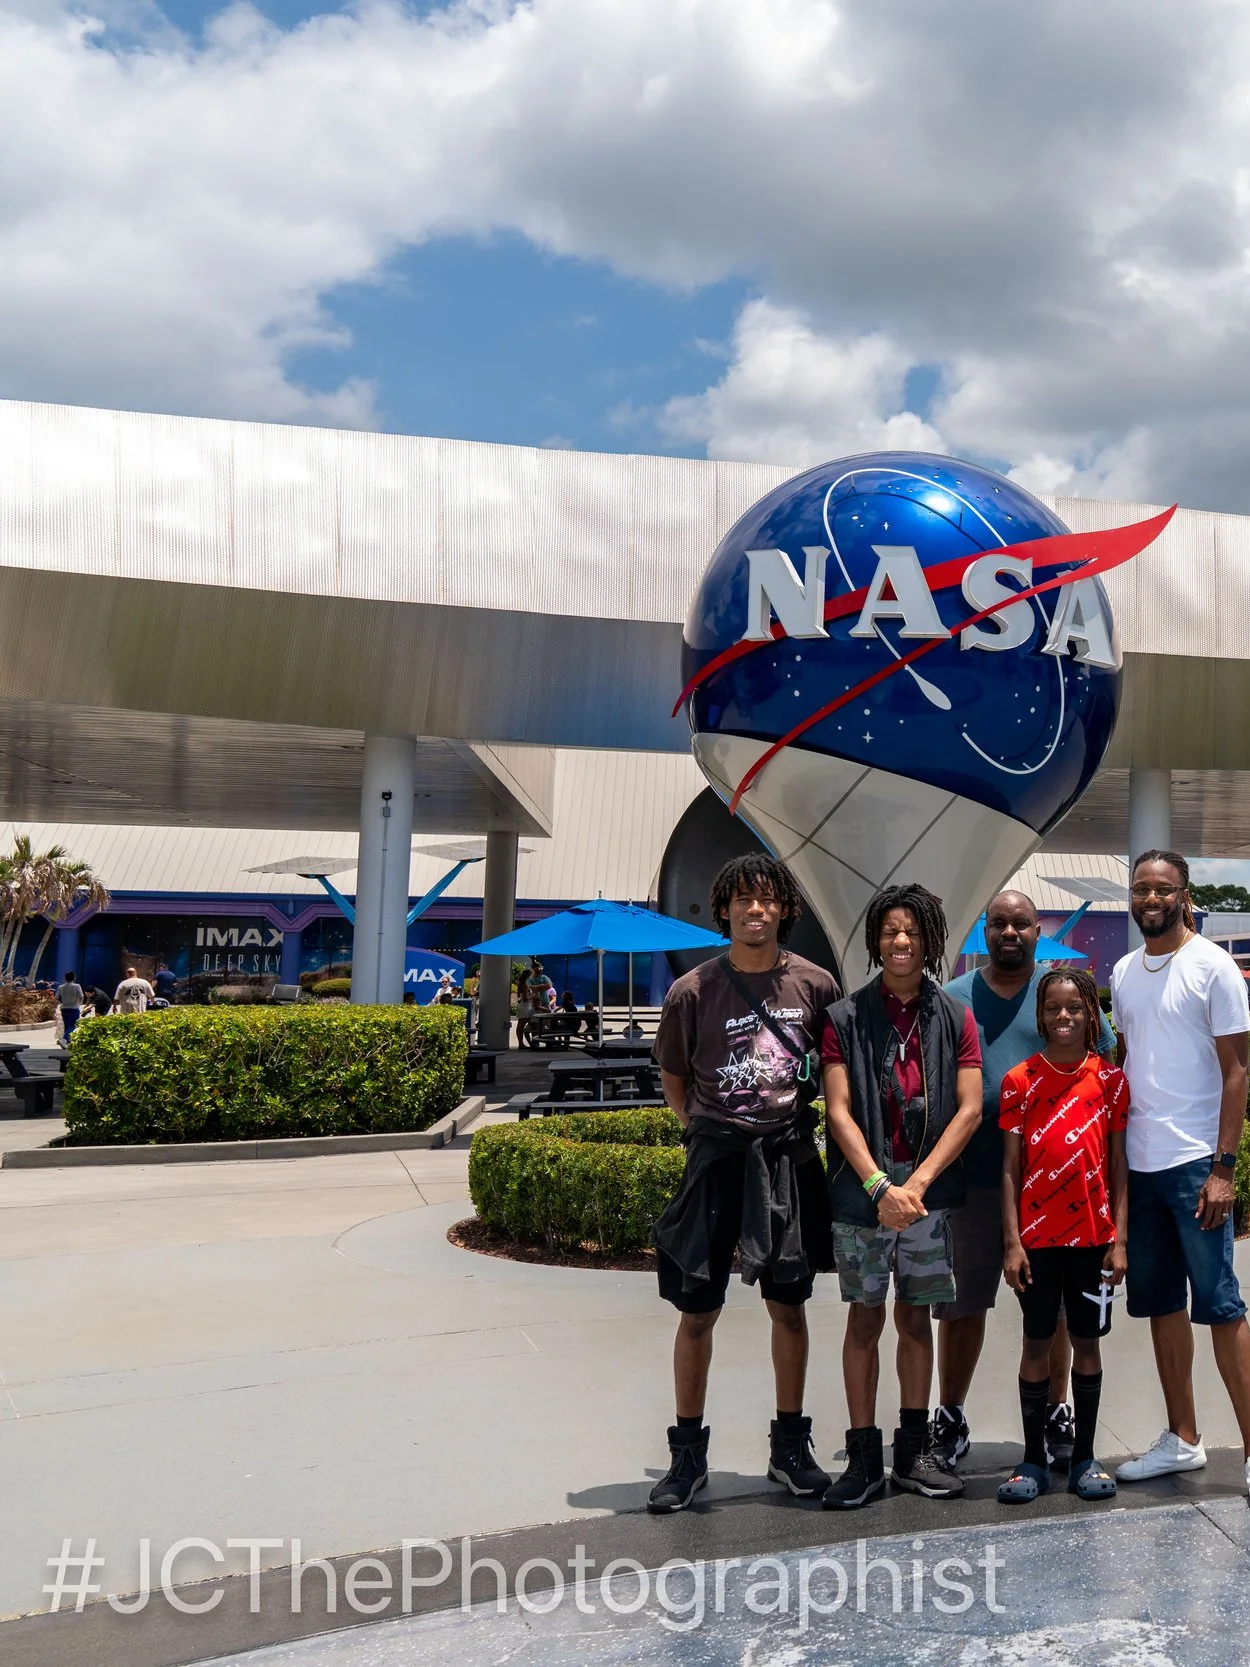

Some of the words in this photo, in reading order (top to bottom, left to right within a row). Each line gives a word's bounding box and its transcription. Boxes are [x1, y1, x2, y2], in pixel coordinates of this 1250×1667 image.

[743, 545, 1117, 668] NASA
[196, 927, 284, 947] IMAX
[203, 953, 244, 972] DEEP
[253, 954, 281, 972] SKY
[404, 968, 457, 983] MAX
[1030, 1096, 1080, 1145] Champion
[1048, 1148, 1085, 1181] Champion
